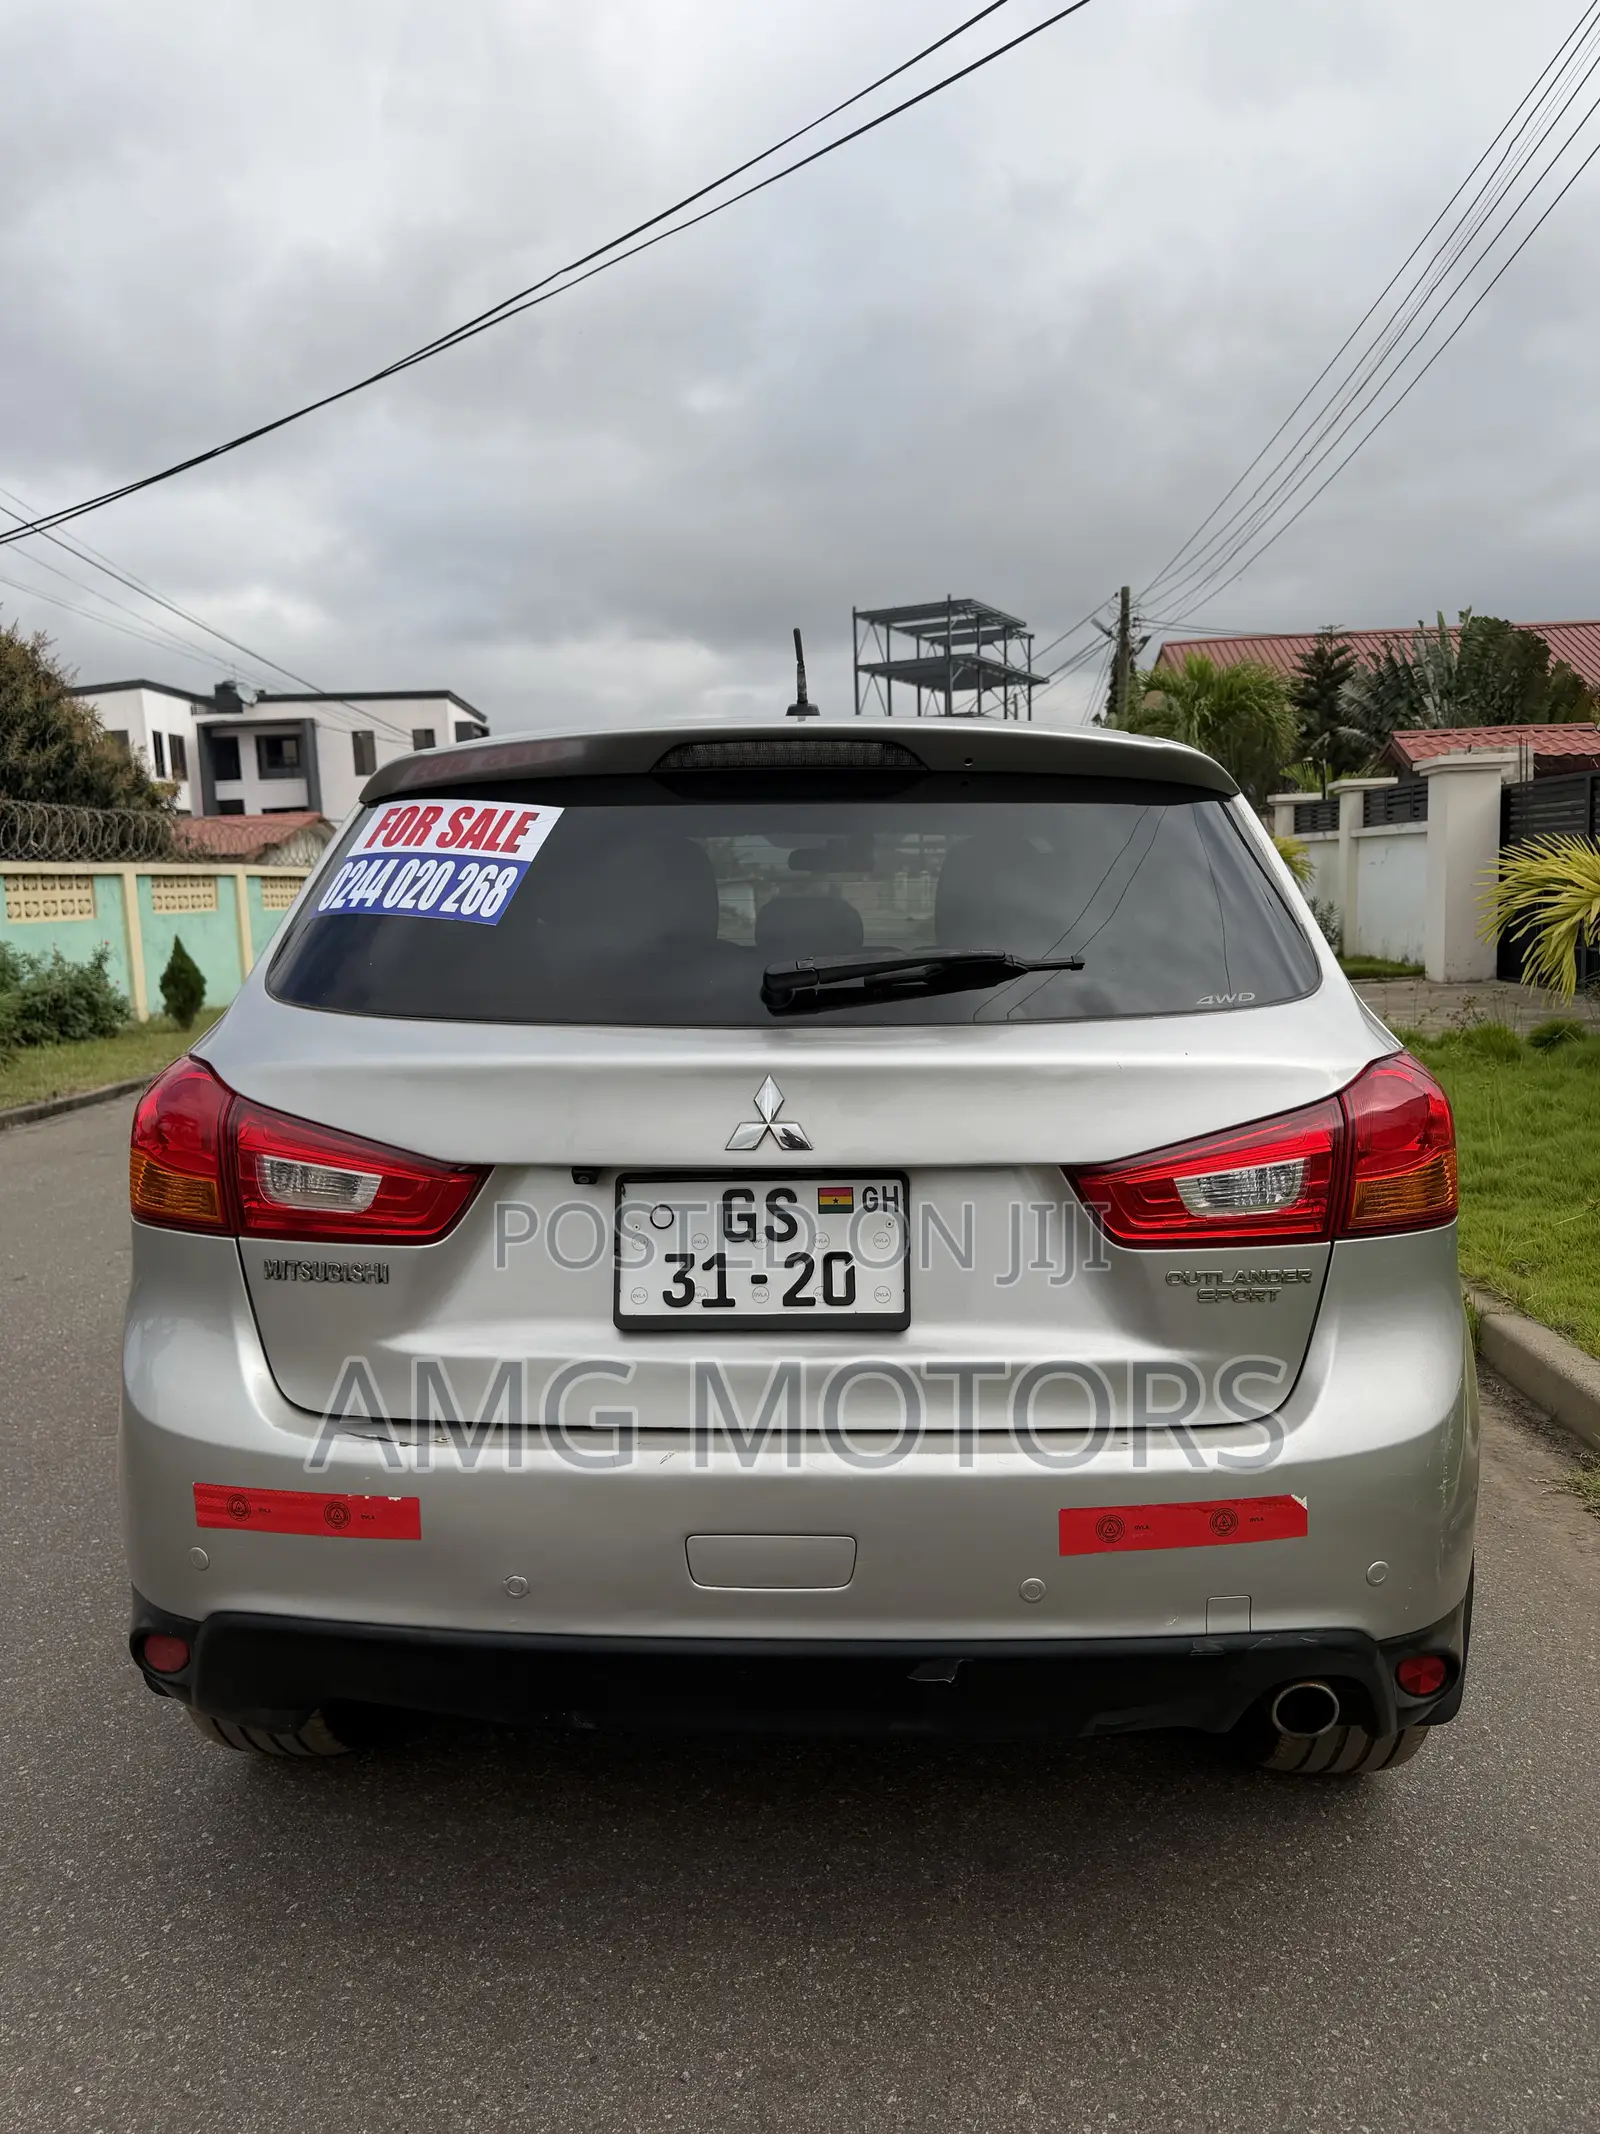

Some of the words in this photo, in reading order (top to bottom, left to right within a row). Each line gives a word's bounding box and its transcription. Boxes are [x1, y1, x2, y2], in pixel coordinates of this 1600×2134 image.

[364, 805, 442, 849] FOR
[435, 805, 541, 853] SALE
[318, 859, 400, 912] 0244
[382, 858, 456, 911] 020
[438, 862, 519, 918] 268
[1196, 991, 1256, 1005] 4WD
[861, 1185, 899, 1213] GH
[722, 1188, 798, 1242] GS
[263, 1258, 389, 1285] MITSUBISHI
[1165, 1268, 1313, 1287] OUTLANDER
[1197, 1286, 1282, 1304] SPORT
